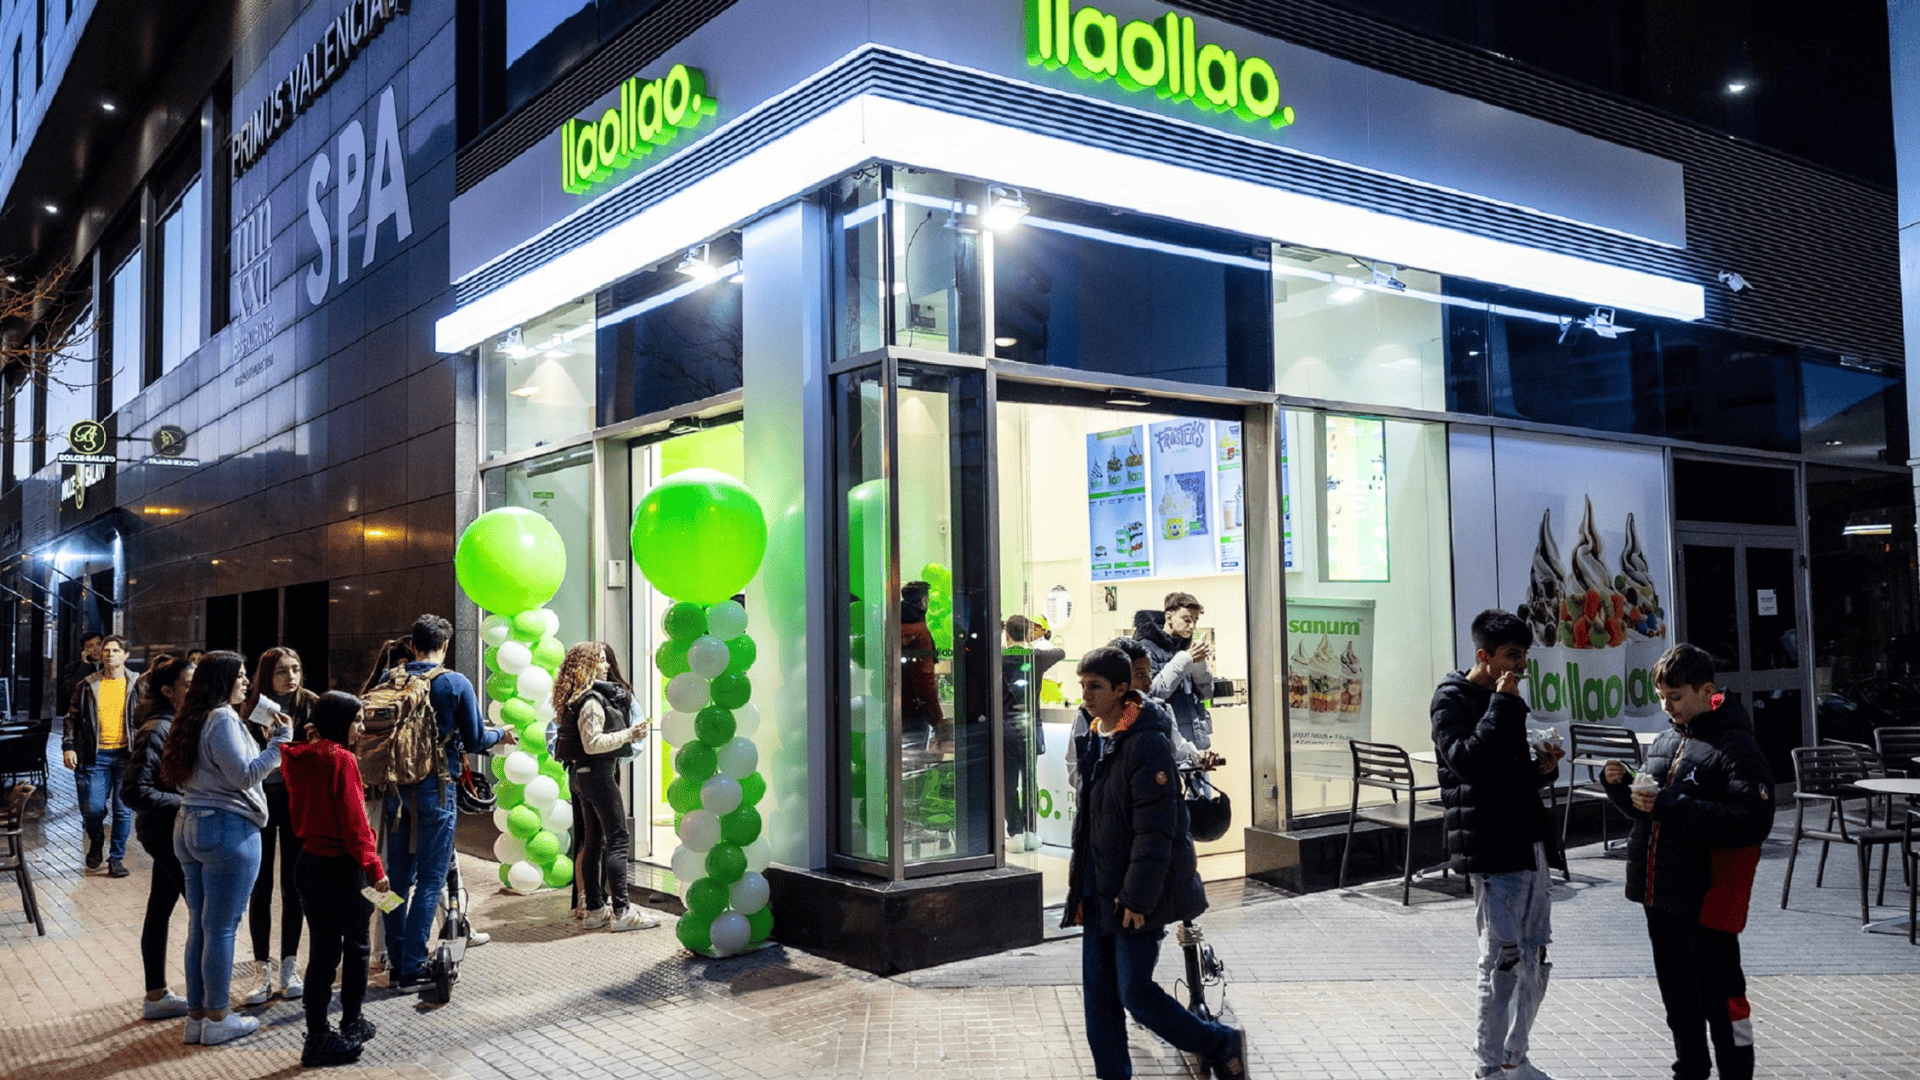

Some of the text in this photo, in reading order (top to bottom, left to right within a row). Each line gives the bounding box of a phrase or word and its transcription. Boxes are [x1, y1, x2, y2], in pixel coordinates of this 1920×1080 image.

[232, 0, 385, 178] PRIMUS VALENCIA
[561, 63, 716, 193] llaollao.
[1033, 0, 1295, 126] llaollao.
[306, 85, 413, 305] SPA
[1288, 619, 1360, 635] sanum
